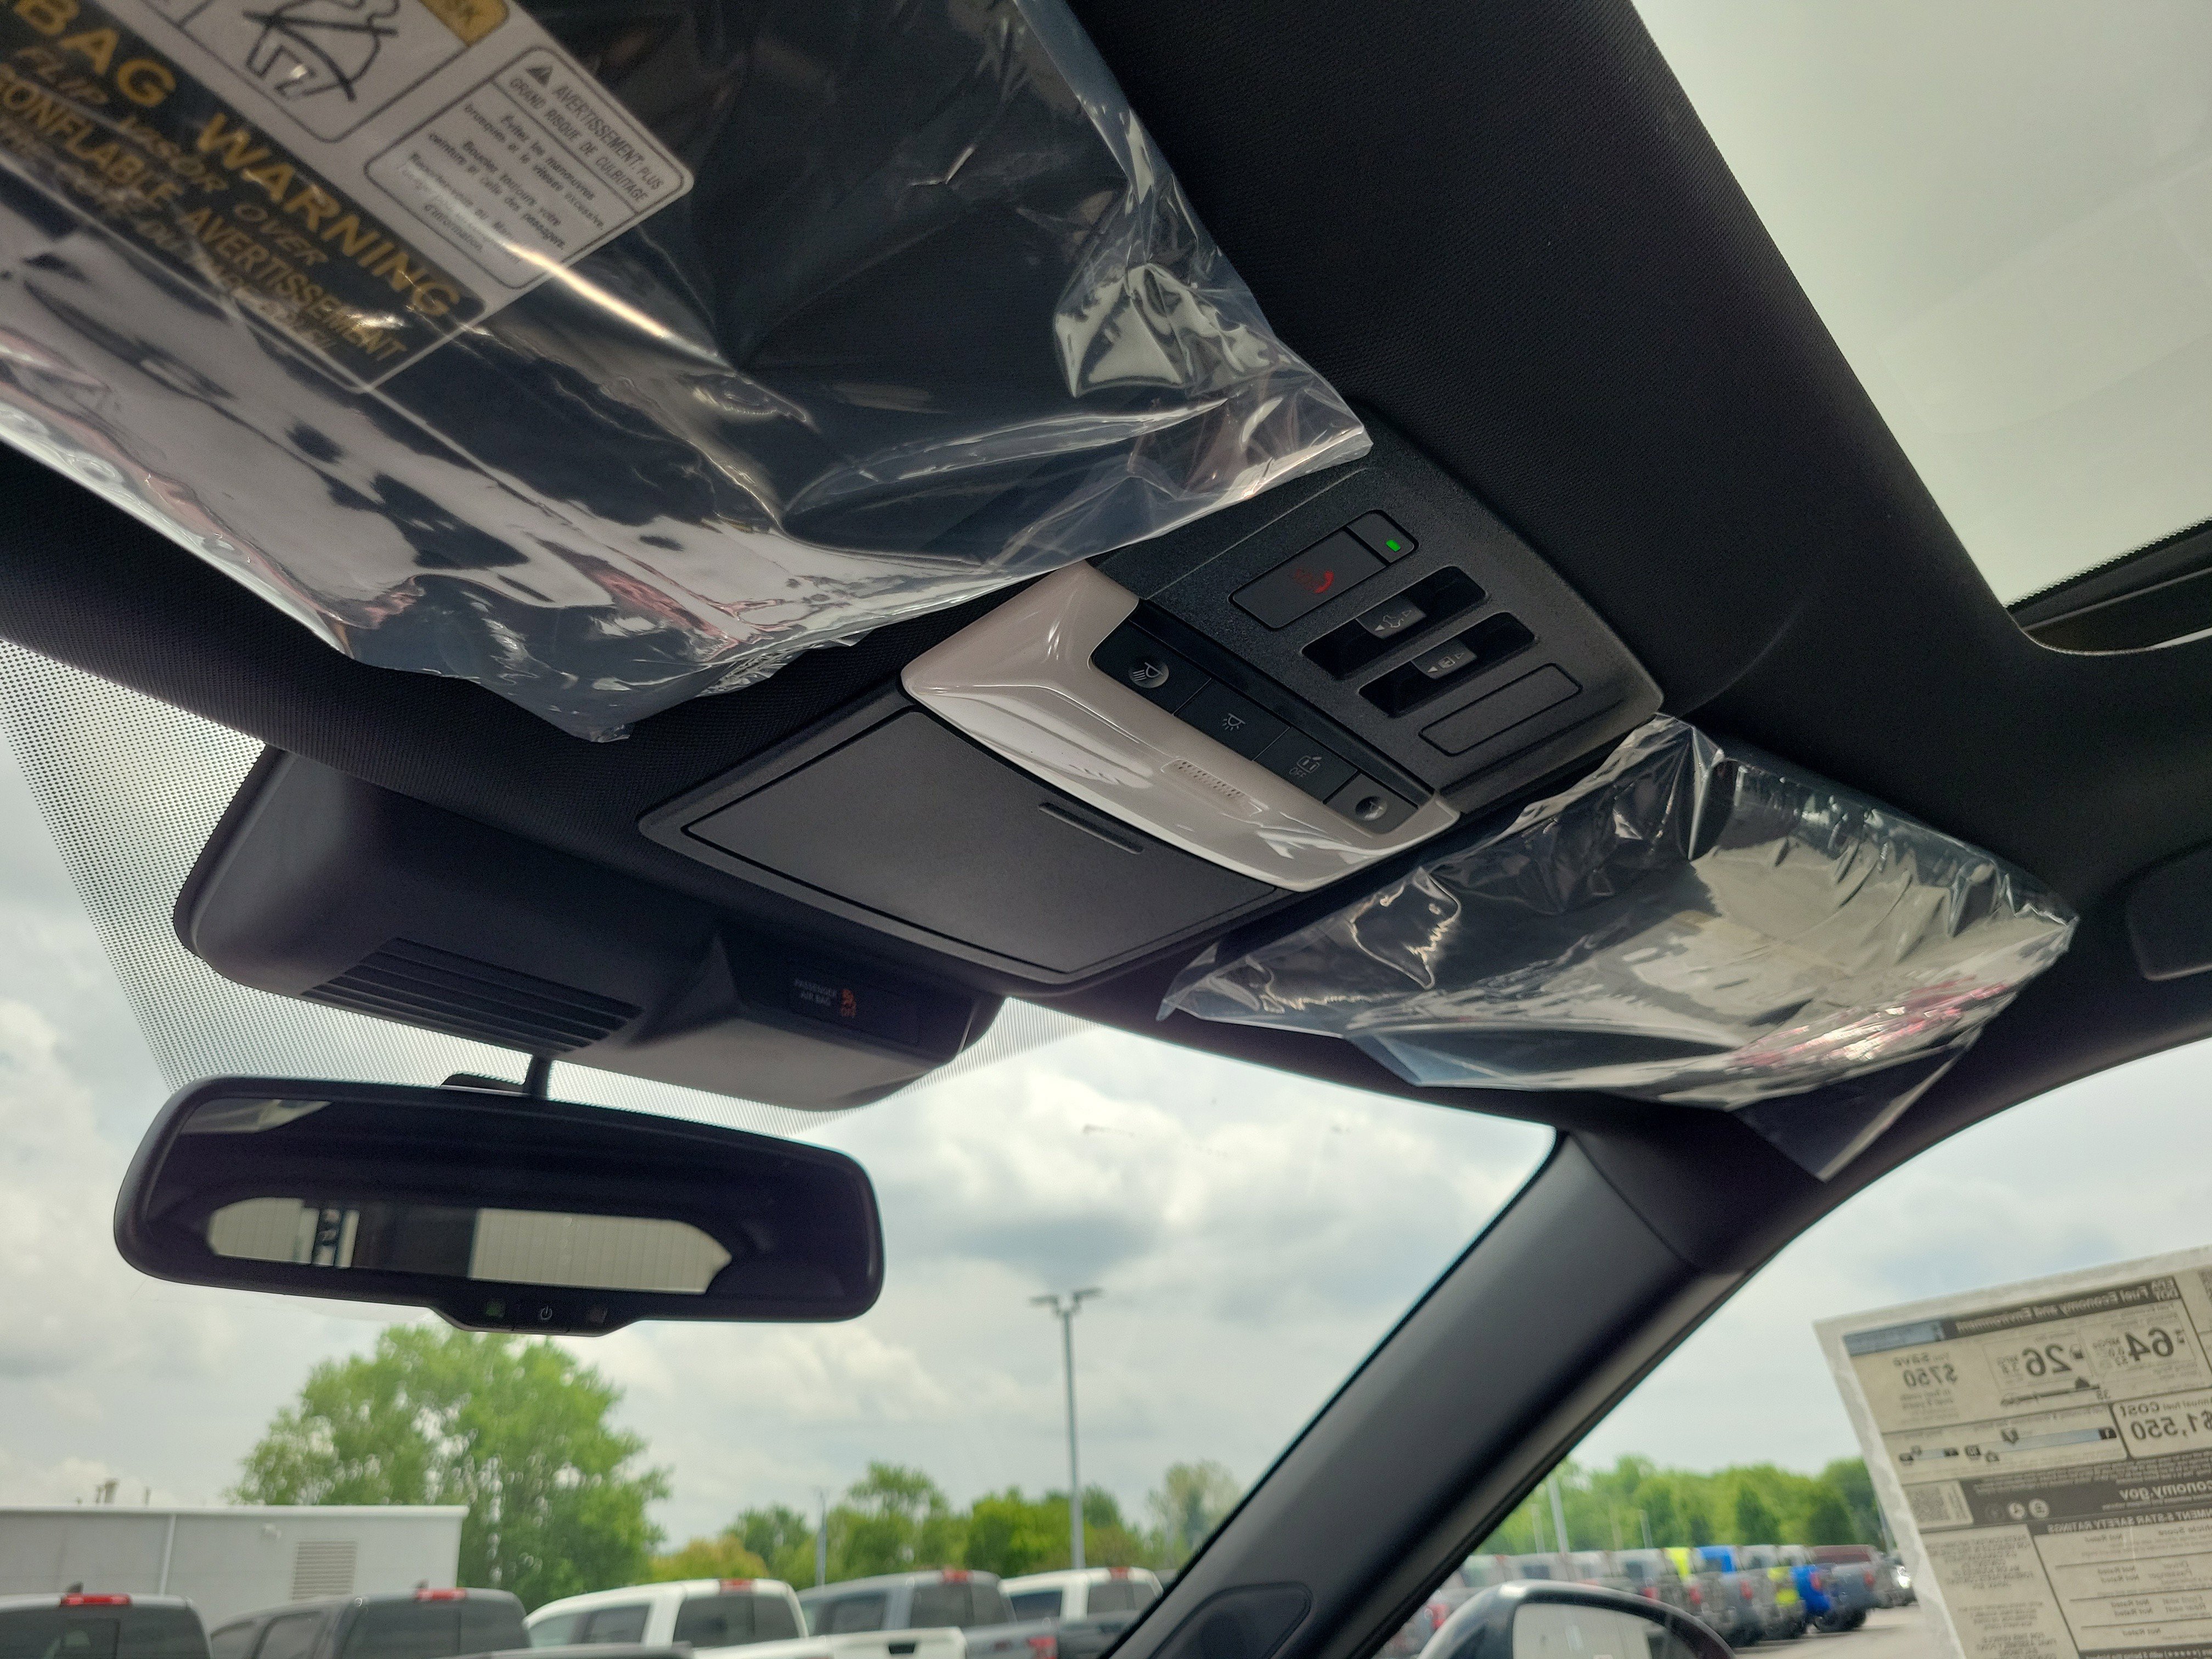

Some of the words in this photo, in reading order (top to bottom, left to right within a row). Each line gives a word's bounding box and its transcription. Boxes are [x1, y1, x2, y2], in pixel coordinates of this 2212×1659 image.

[14, 47, 110, 105] FLIP
[234, 203, 329, 266] OVER
[198, 112, 460, 317] WARNING
[510, 77, 546, 114] GRAND
[547, 108, 582, 143] RISQUE
[579, 138, 598, 157] DE
[595, 153, 650, 203] CULBUTAGE
[637, 165, 665, 192] PLUS
